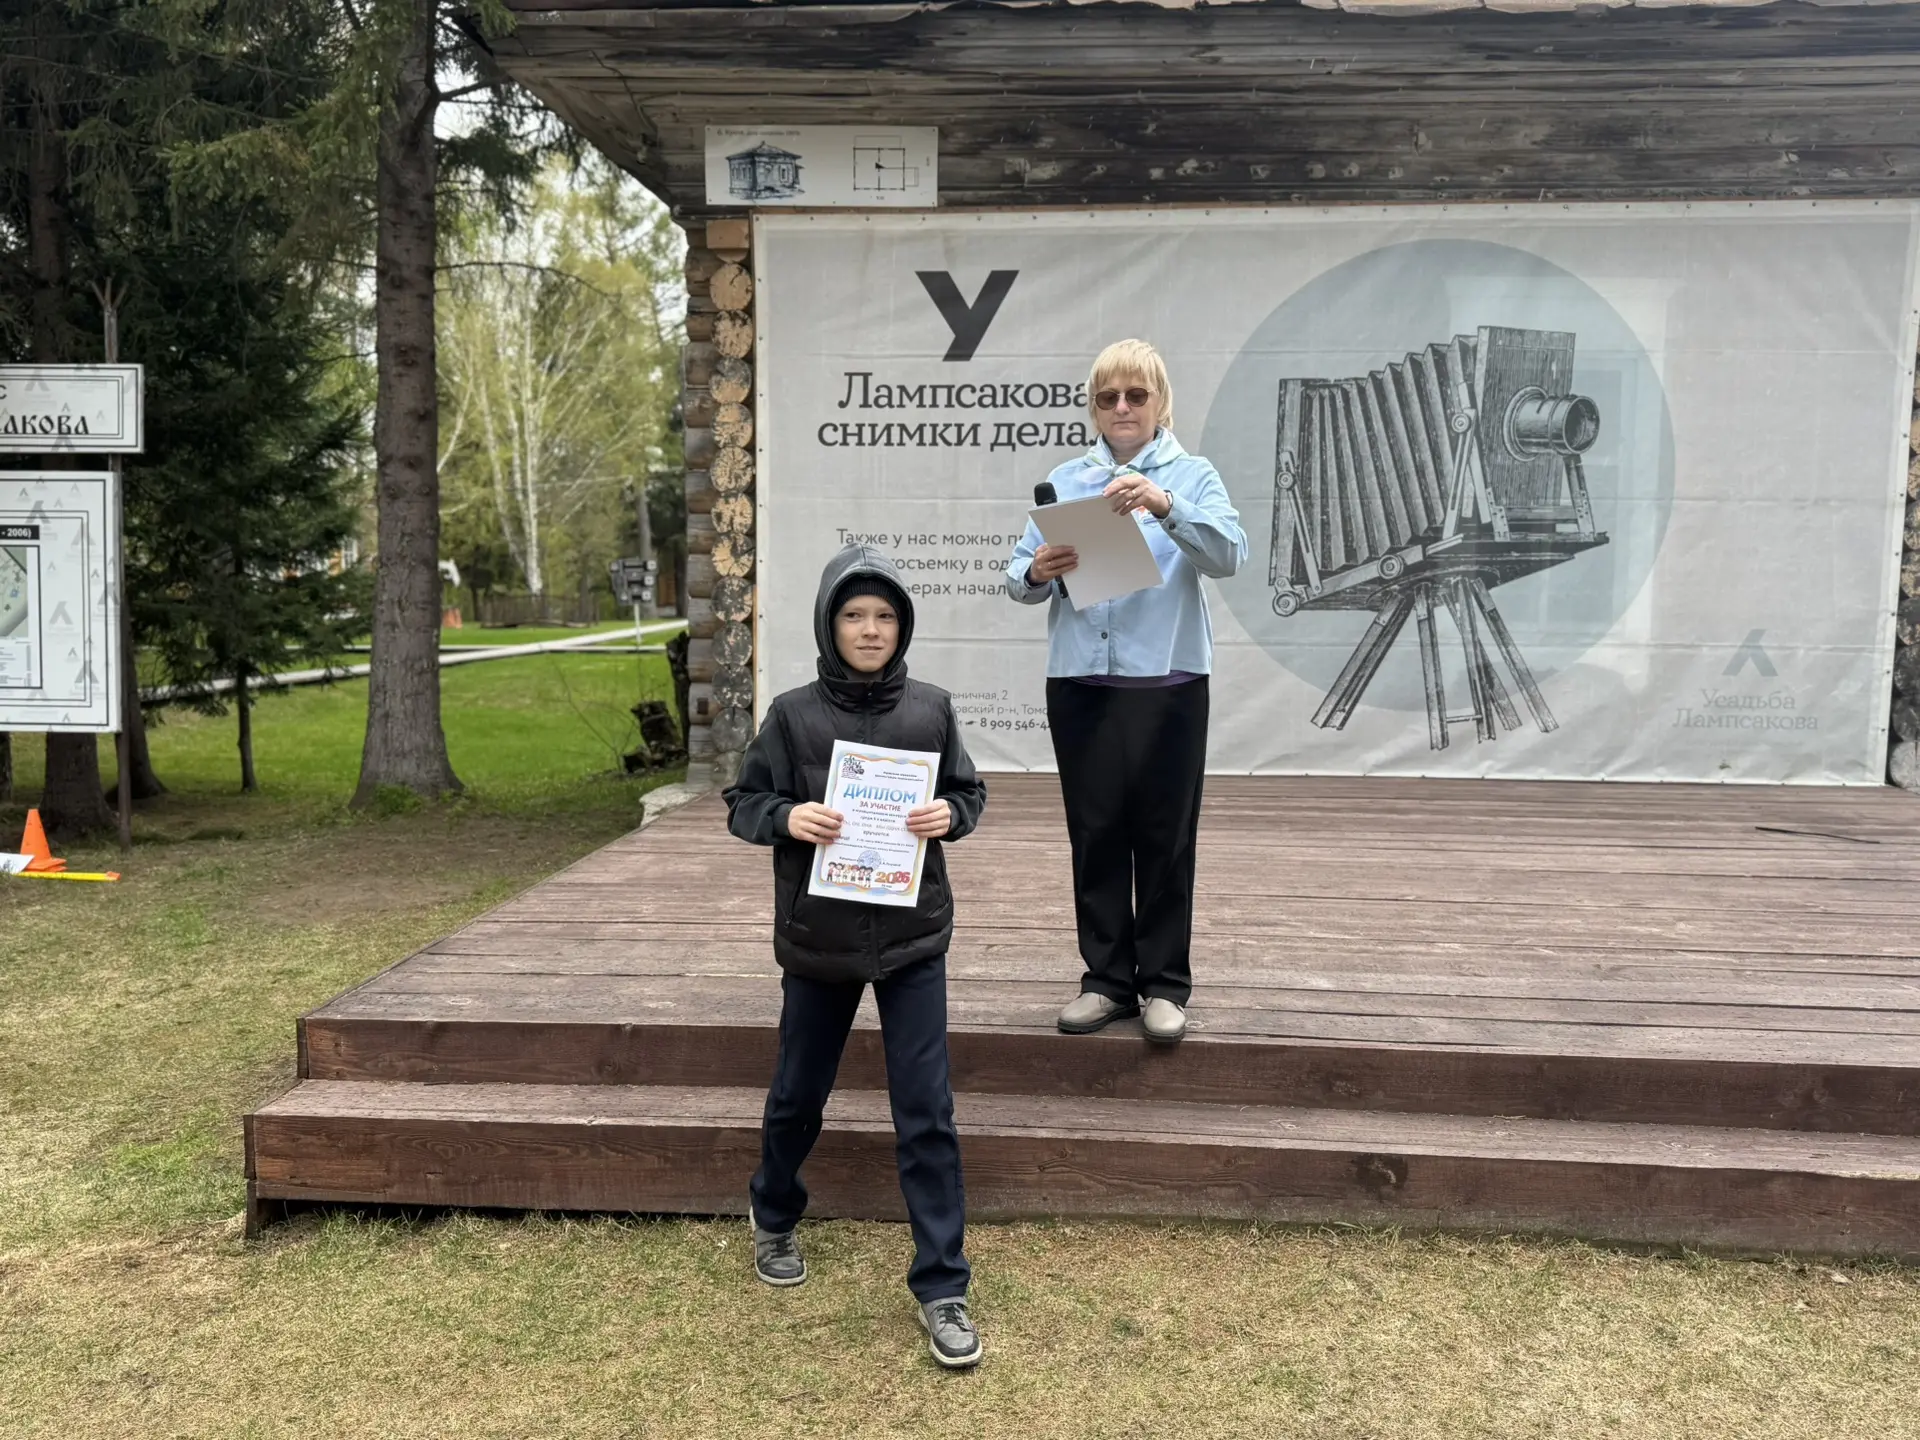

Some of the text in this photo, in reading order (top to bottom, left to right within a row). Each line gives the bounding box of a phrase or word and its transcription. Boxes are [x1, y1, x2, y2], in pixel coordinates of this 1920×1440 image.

[0, 415, 89, 435] АКОВА
[817, 422, 981, 447] снимки
[7, 528, 32, 538] 2006)
[836, 528, 888, 545] Также
[893, 534, 903, 548] у
[908, 534, 937, 545] нас
[943, 534, 1002, 545] можно
[891, 558, 969, 574] осъемку
[974, 560, 984, 571] в
[951, 690, 1009, 701] ьничная, 2
[1701, 688, 1796, 711] Усадьба
[997, 707, 1019, 716] р-н,
[1672, 708, 1818, 730] Лампсакова
[980, 717, 1051, 731] 8 909 546-4
[843, 783, 917, 804] ДИПЛОМ
[870, 802, 901, 812] УЧАСТИЕ
